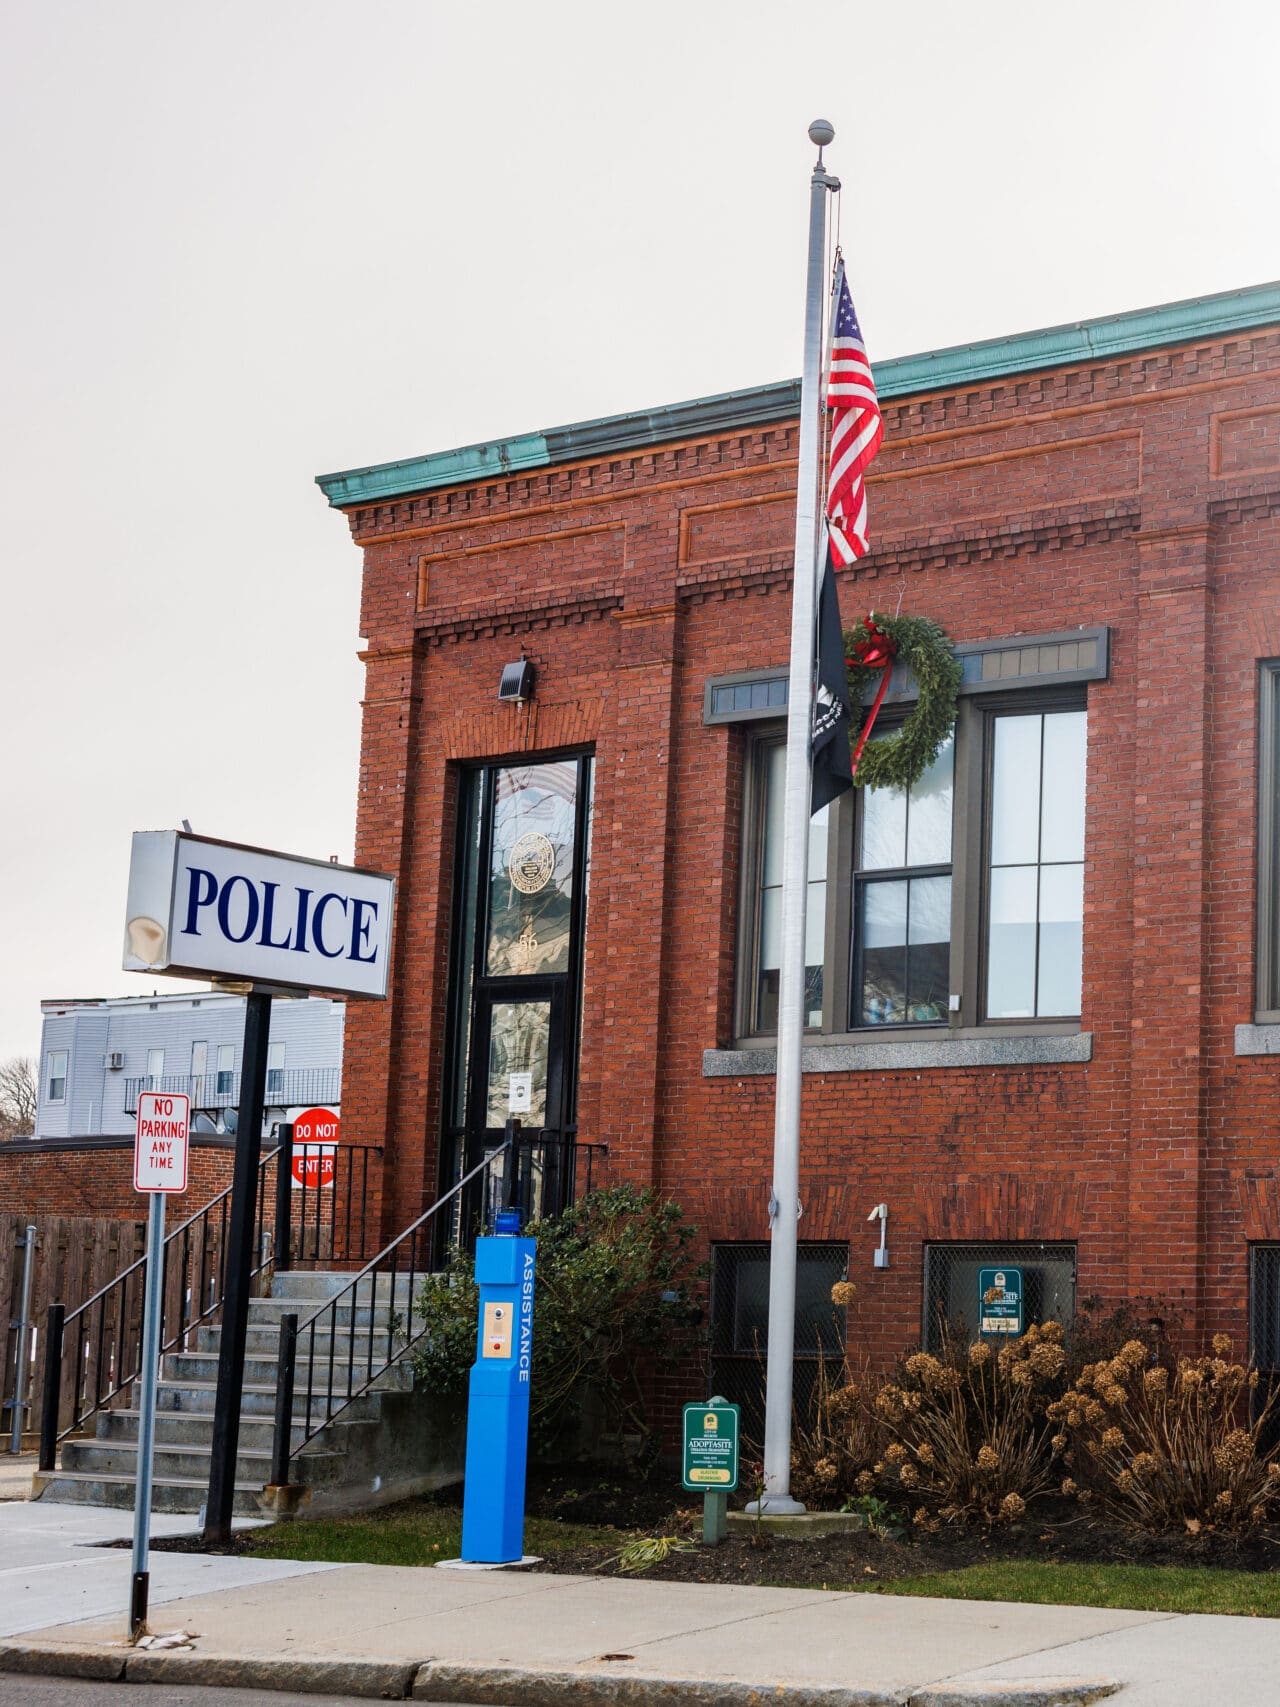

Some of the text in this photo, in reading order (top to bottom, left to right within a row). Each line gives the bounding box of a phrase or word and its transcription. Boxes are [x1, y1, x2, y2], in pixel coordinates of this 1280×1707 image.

[181, 867, 378, 963] POLICE
[153, 1098, 173, 1116] NO
[141, 1120, 185, 1139] PARKING
[296, 1123, 337, 1138] DO NOT
[152, 1141, 172, 1153] ANY
[149, 1156, 173, 1169] TIME
[298, 1159, 333, 1174] ENTER
[518, 1253, 533, 1383] ASSISTANCE
